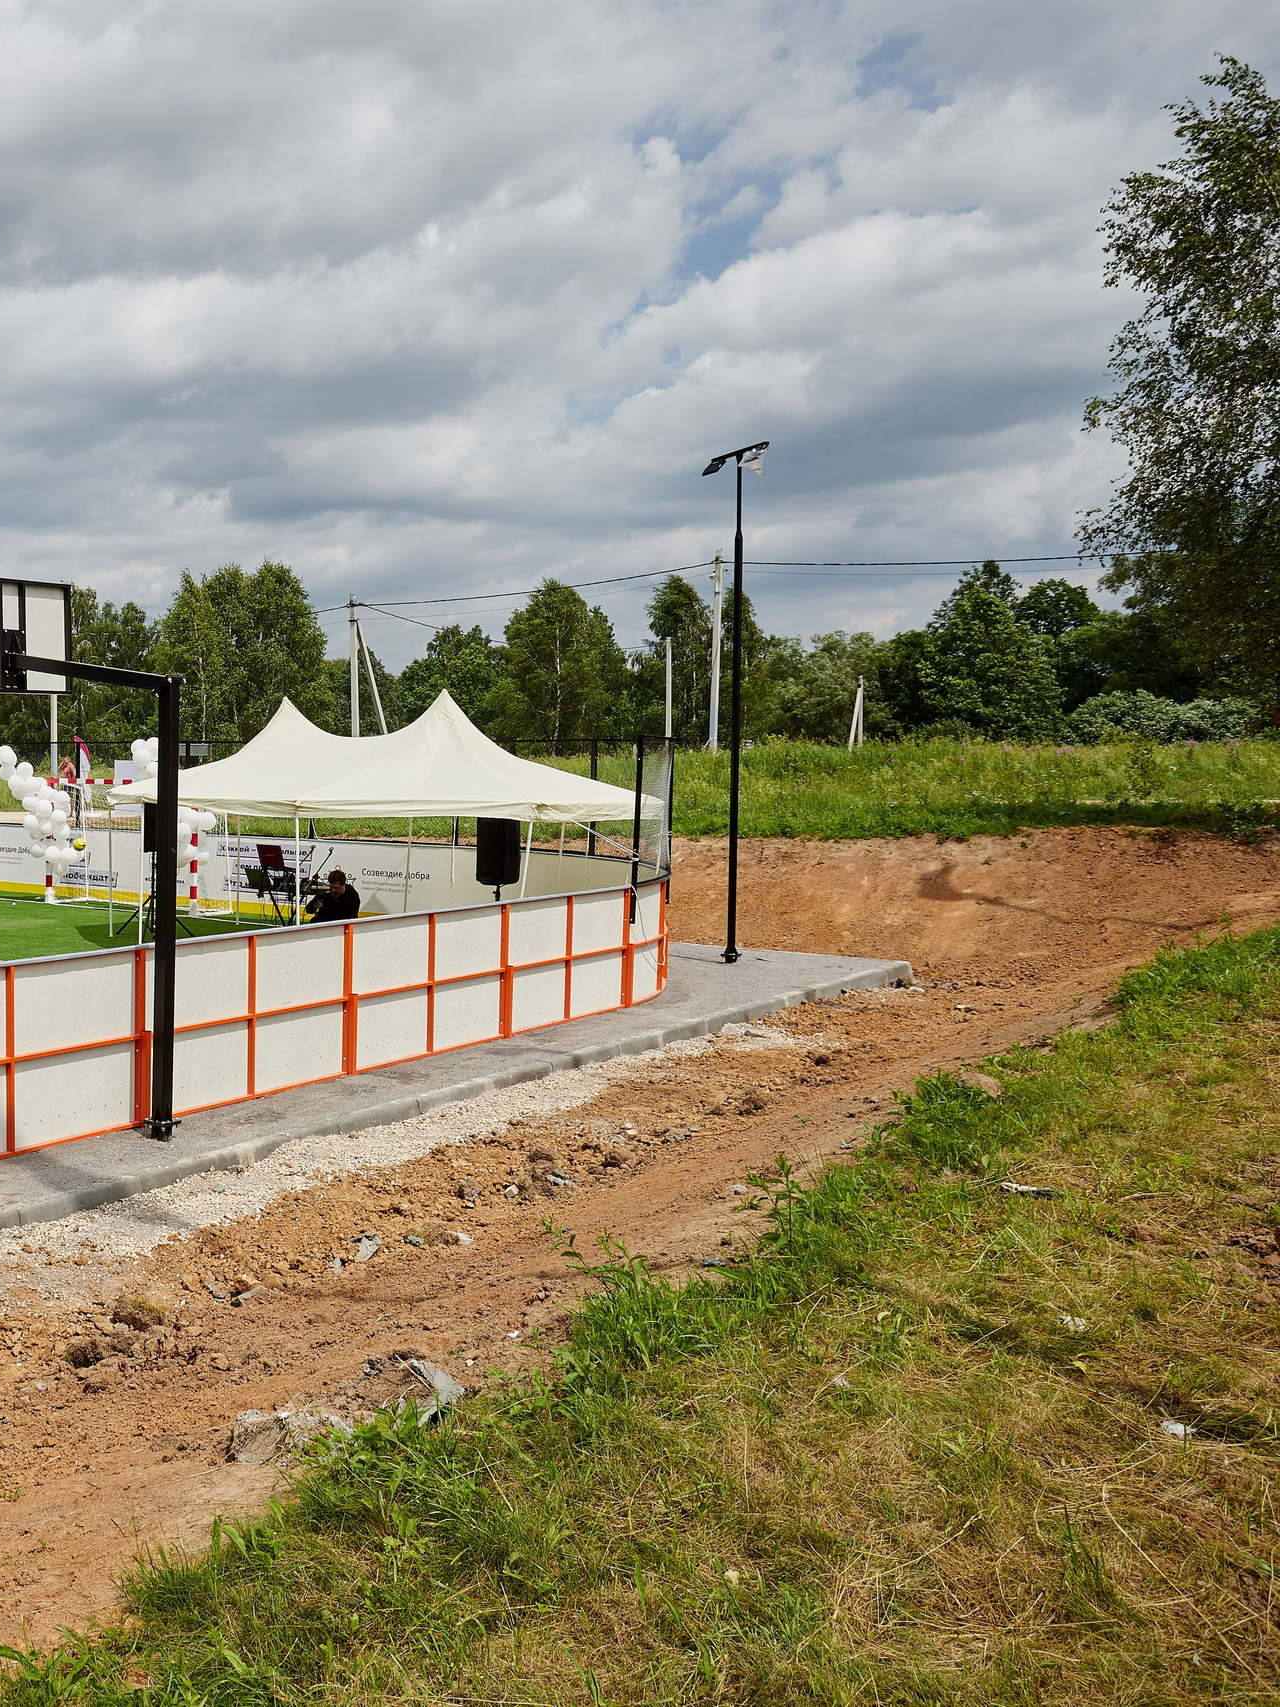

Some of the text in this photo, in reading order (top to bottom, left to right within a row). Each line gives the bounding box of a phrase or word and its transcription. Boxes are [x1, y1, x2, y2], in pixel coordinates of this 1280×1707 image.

[17, 846, 31, 855] Добр
[361, 868, 430, 881] Созвездие Добра
